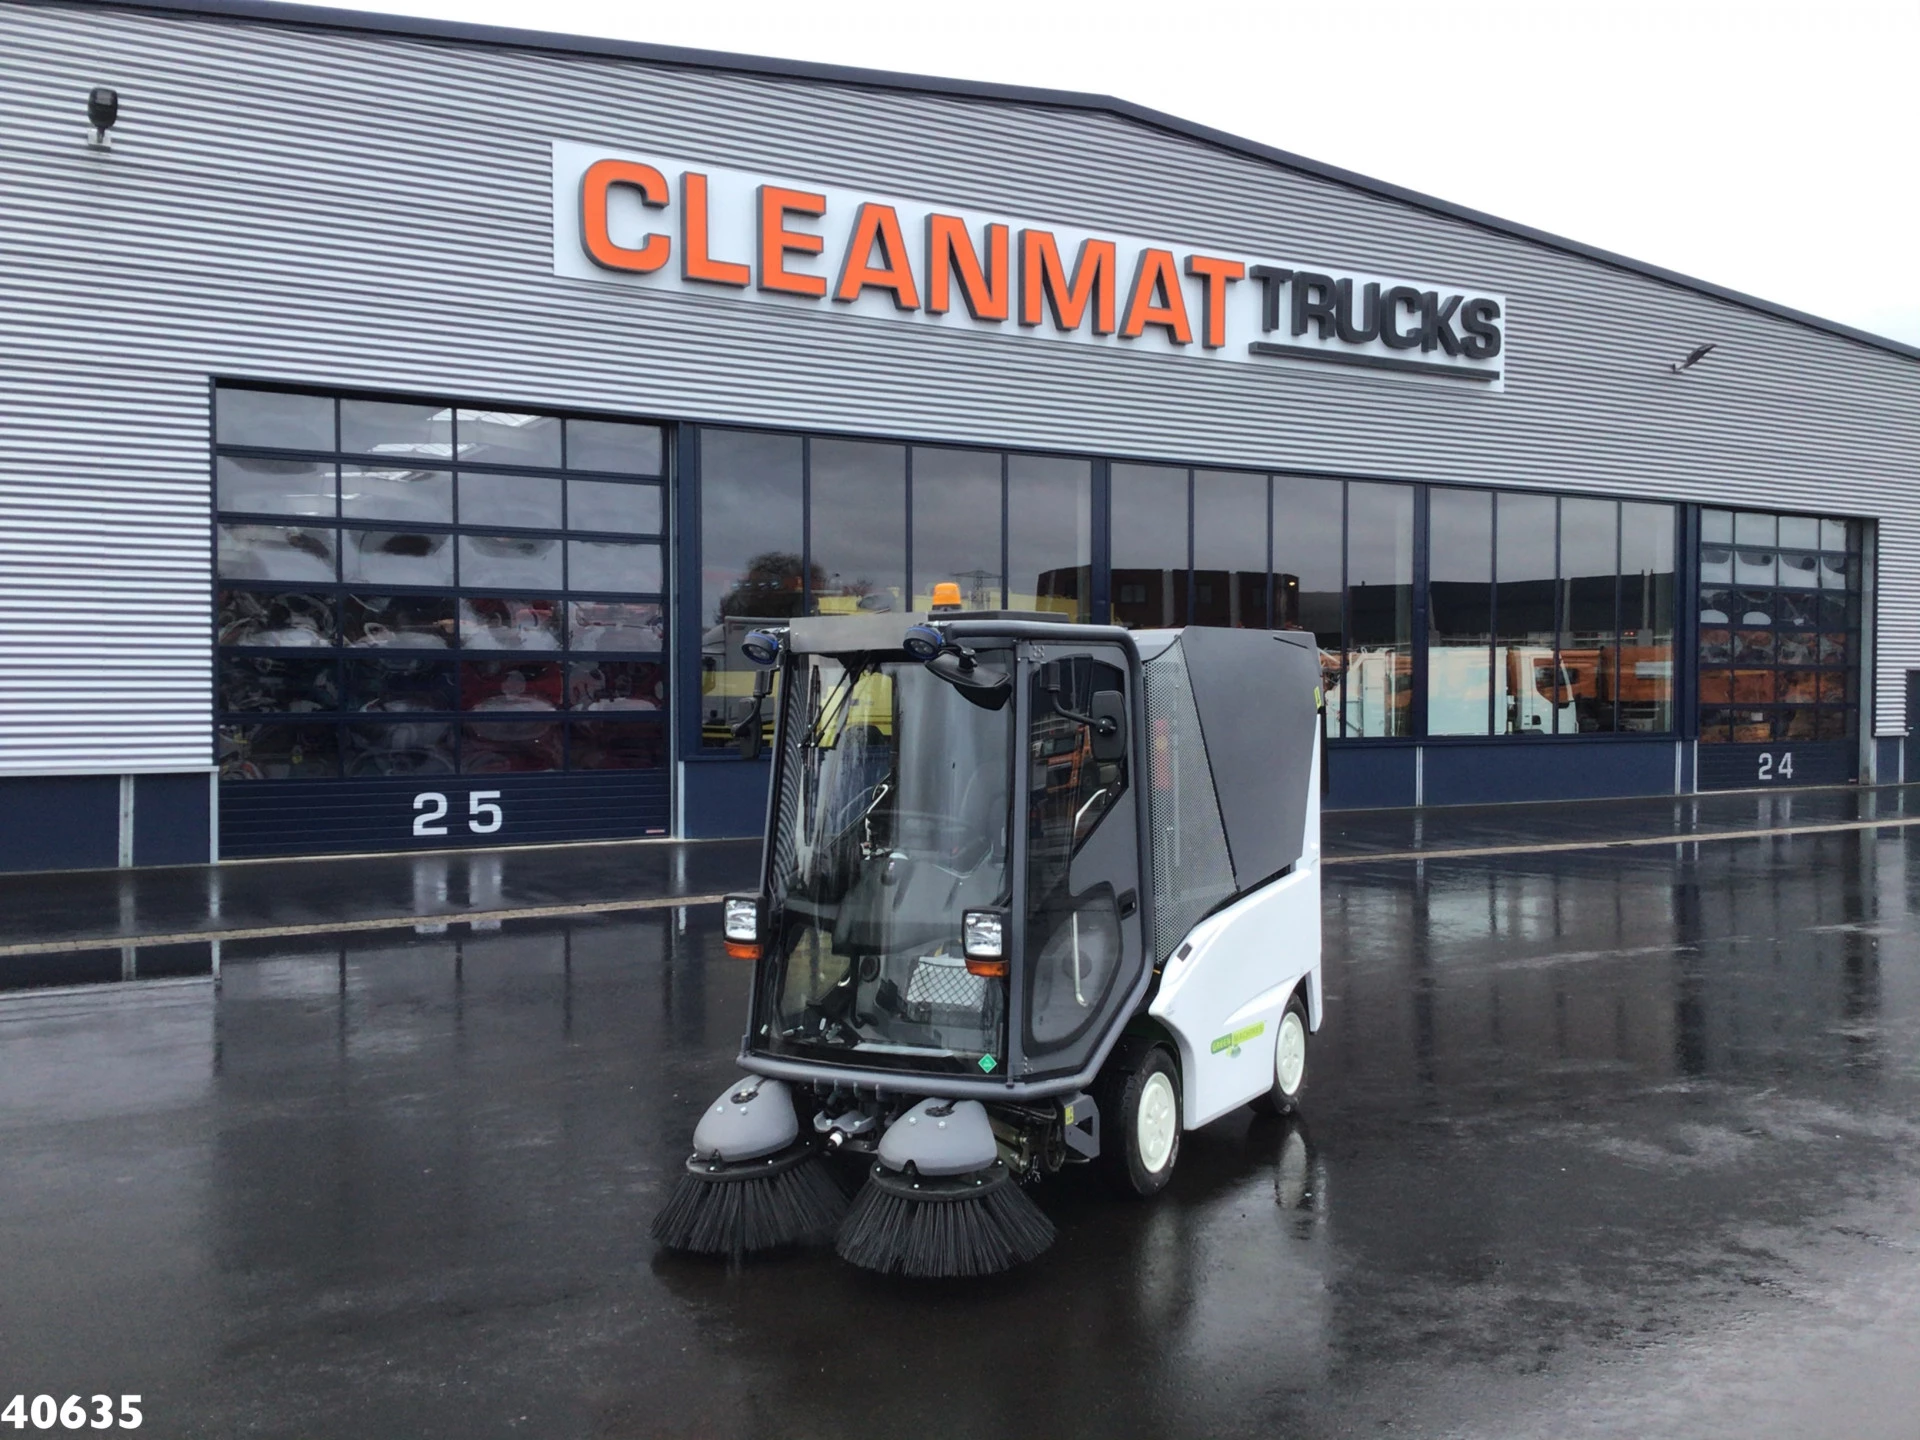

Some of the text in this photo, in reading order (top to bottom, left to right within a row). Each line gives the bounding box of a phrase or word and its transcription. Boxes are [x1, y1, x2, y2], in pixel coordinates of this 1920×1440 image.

[579, 158, 1502, 359] CLEANMAT TRUCKS
[1759, 752, 1793, 780] 24
